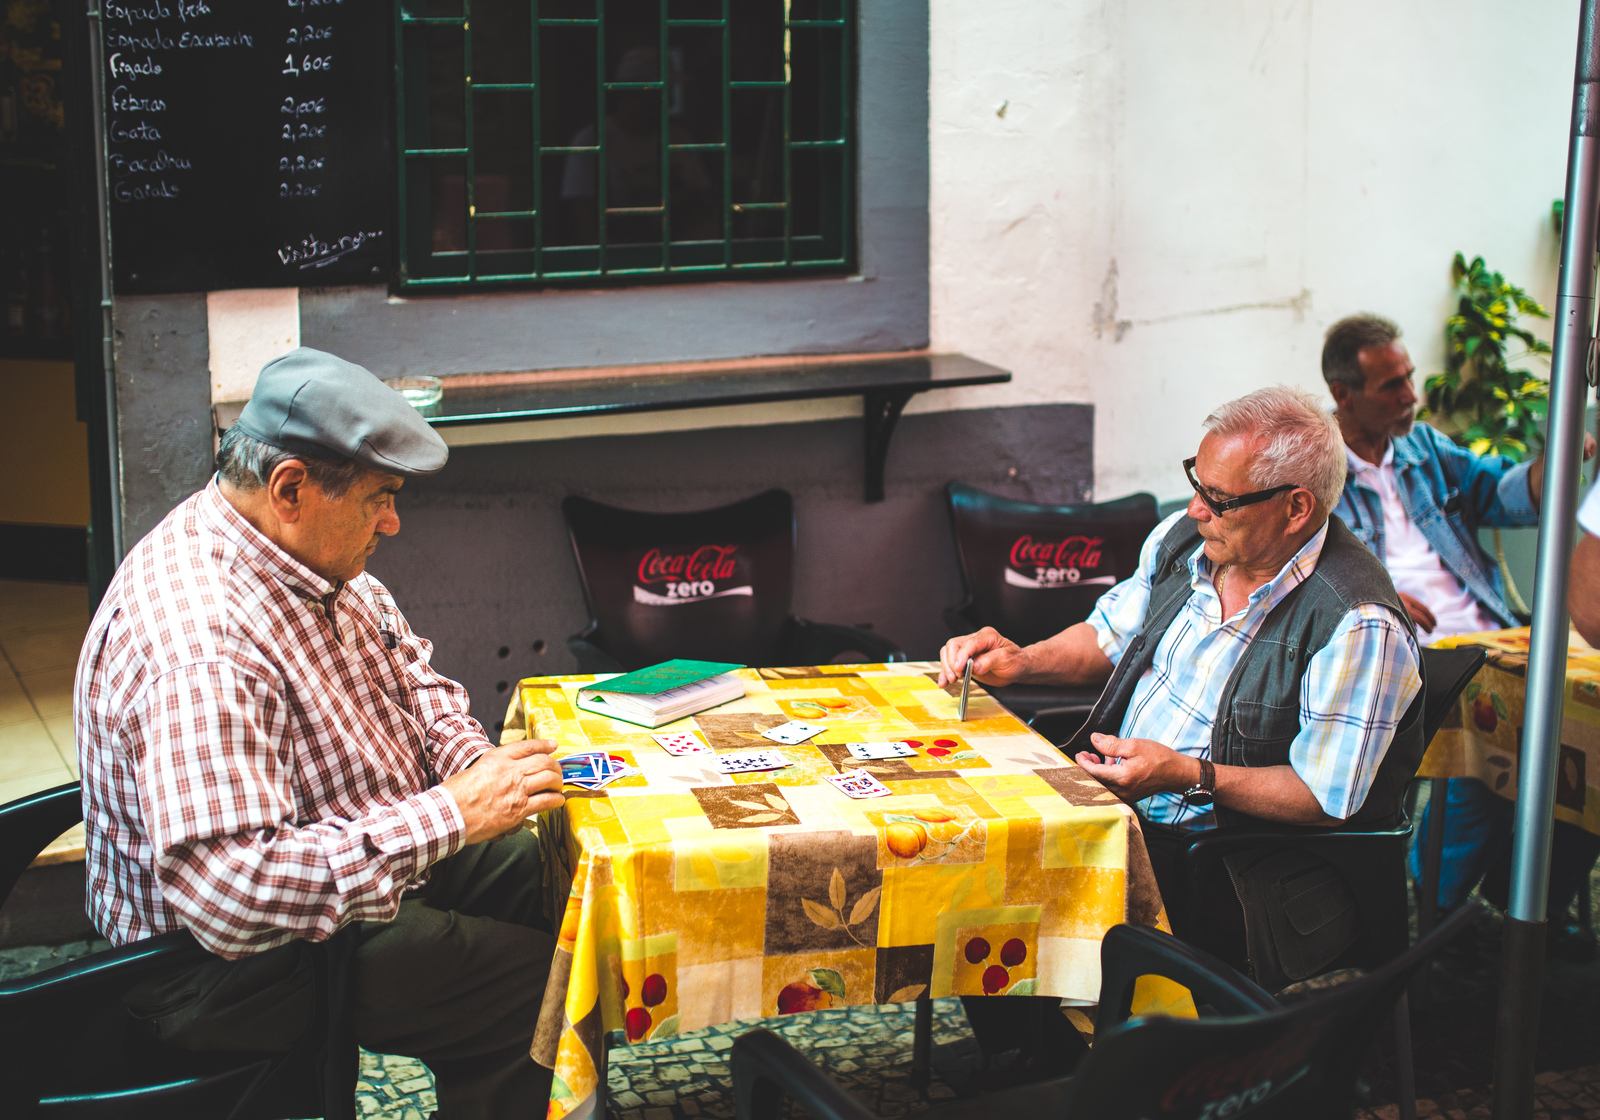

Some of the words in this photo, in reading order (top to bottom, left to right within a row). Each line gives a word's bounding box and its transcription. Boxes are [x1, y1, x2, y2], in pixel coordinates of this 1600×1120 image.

[286, 24, 334, 47] 2,20€
[282, 53, 333, 77] 1,60€
[280, 96, 327, 118] 2,00€
[281, 123, 327, 143] 2,20€
[279, 154, 327, 174] 2,20€
[1036, 568, 1081, 583] zero
[666, 580, 715, 597] zero
